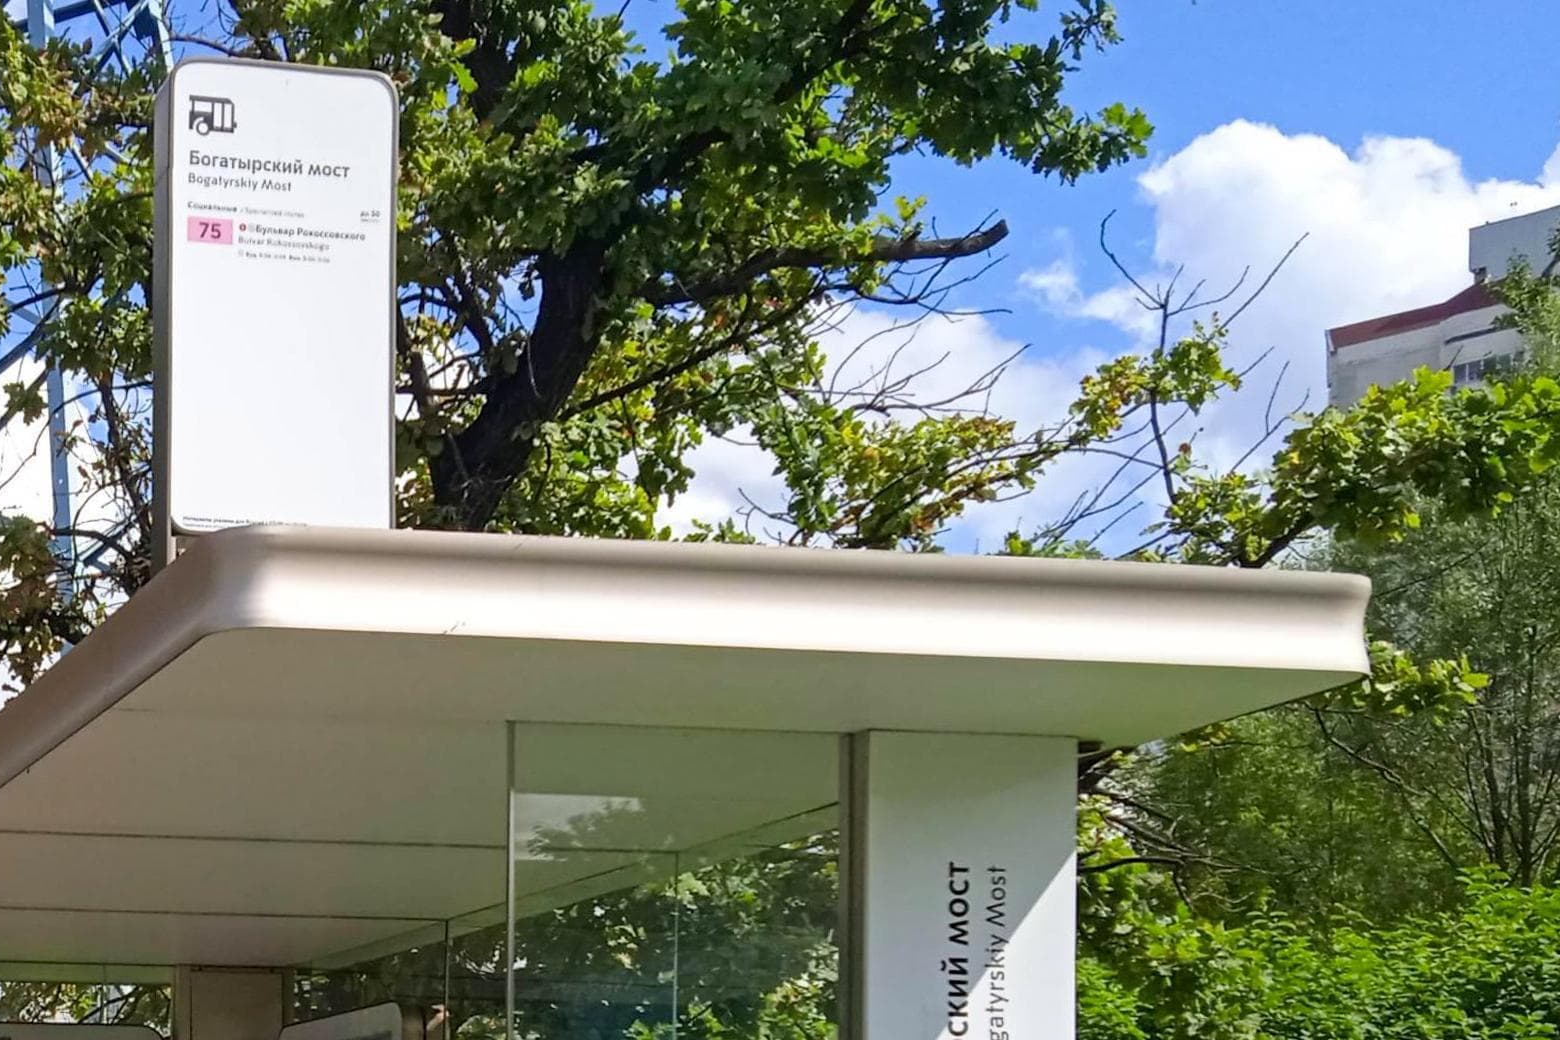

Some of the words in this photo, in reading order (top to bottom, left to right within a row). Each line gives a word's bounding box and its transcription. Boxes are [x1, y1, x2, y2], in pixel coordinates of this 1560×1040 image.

[189, 149, 303, 175] Богатырский
[308, 164, 351, 179] мост
[188, 172, 258, 191] Bogatyrskiy
[261, 179, 292, 192] Most
[199, 221, 222, 240] 75
[256, 224, 295, 237] Бульвар
[297, 227, 366, 241] Рокоссовского
[948, 861, 970, 947] мост
[986, 865, 1007, 929] Most
